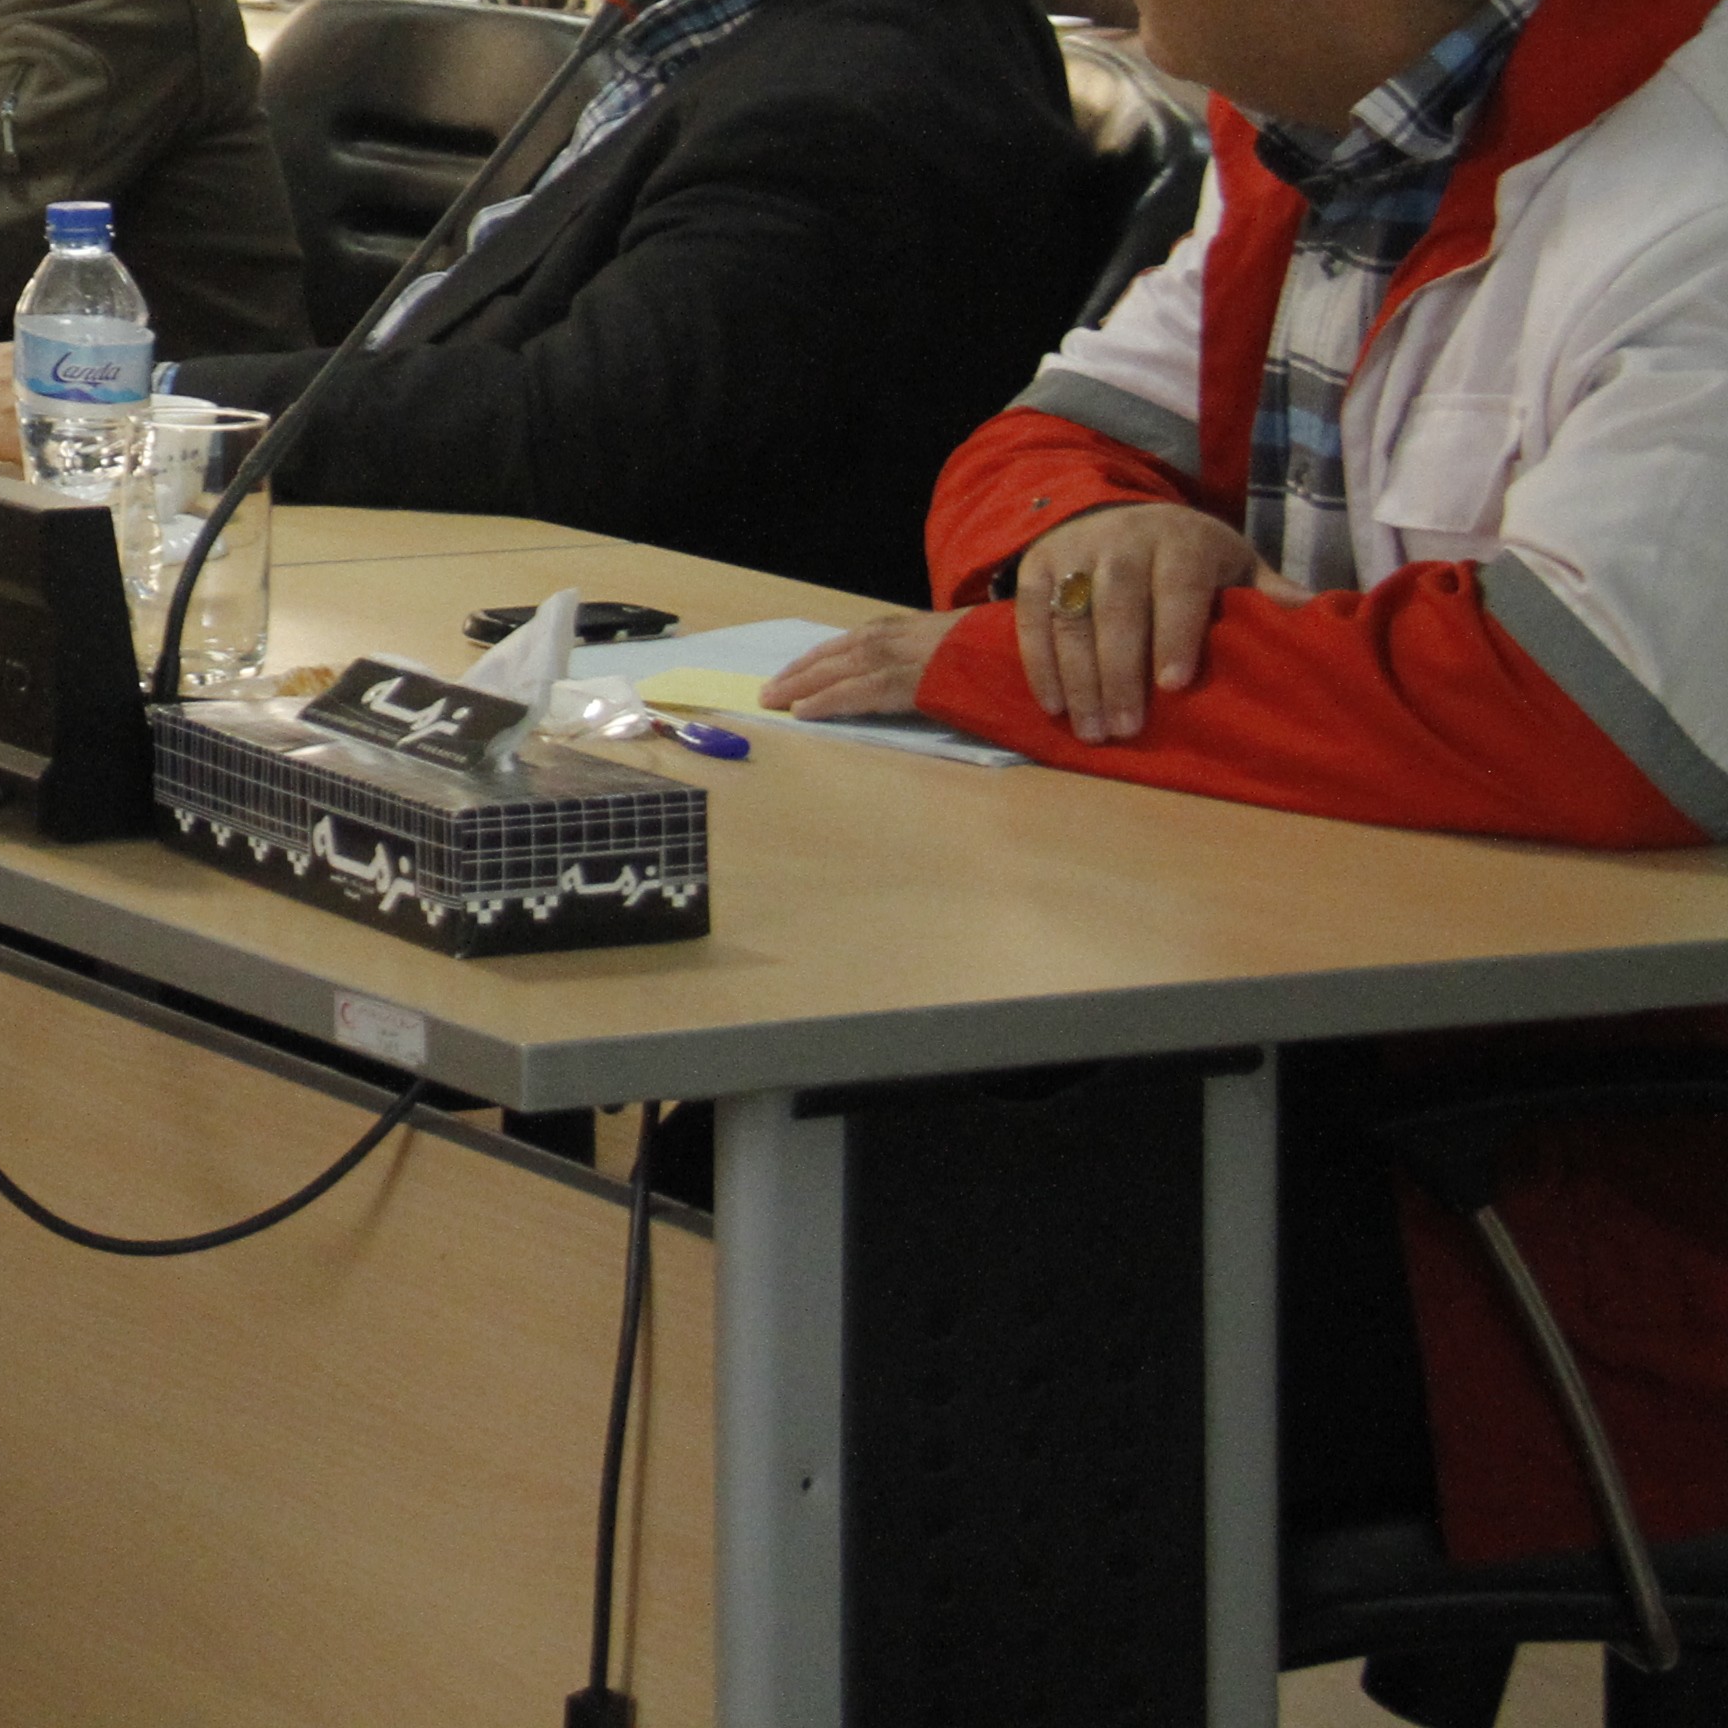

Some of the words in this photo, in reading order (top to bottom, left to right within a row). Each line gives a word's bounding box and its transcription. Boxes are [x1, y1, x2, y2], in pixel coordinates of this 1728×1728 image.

[52, 352, 121, 387] Landa
[361, 676, 470, 747] نرمه
[312, 815, 417, 912] نرمه
[561, 862, 662, 907] نرمه
